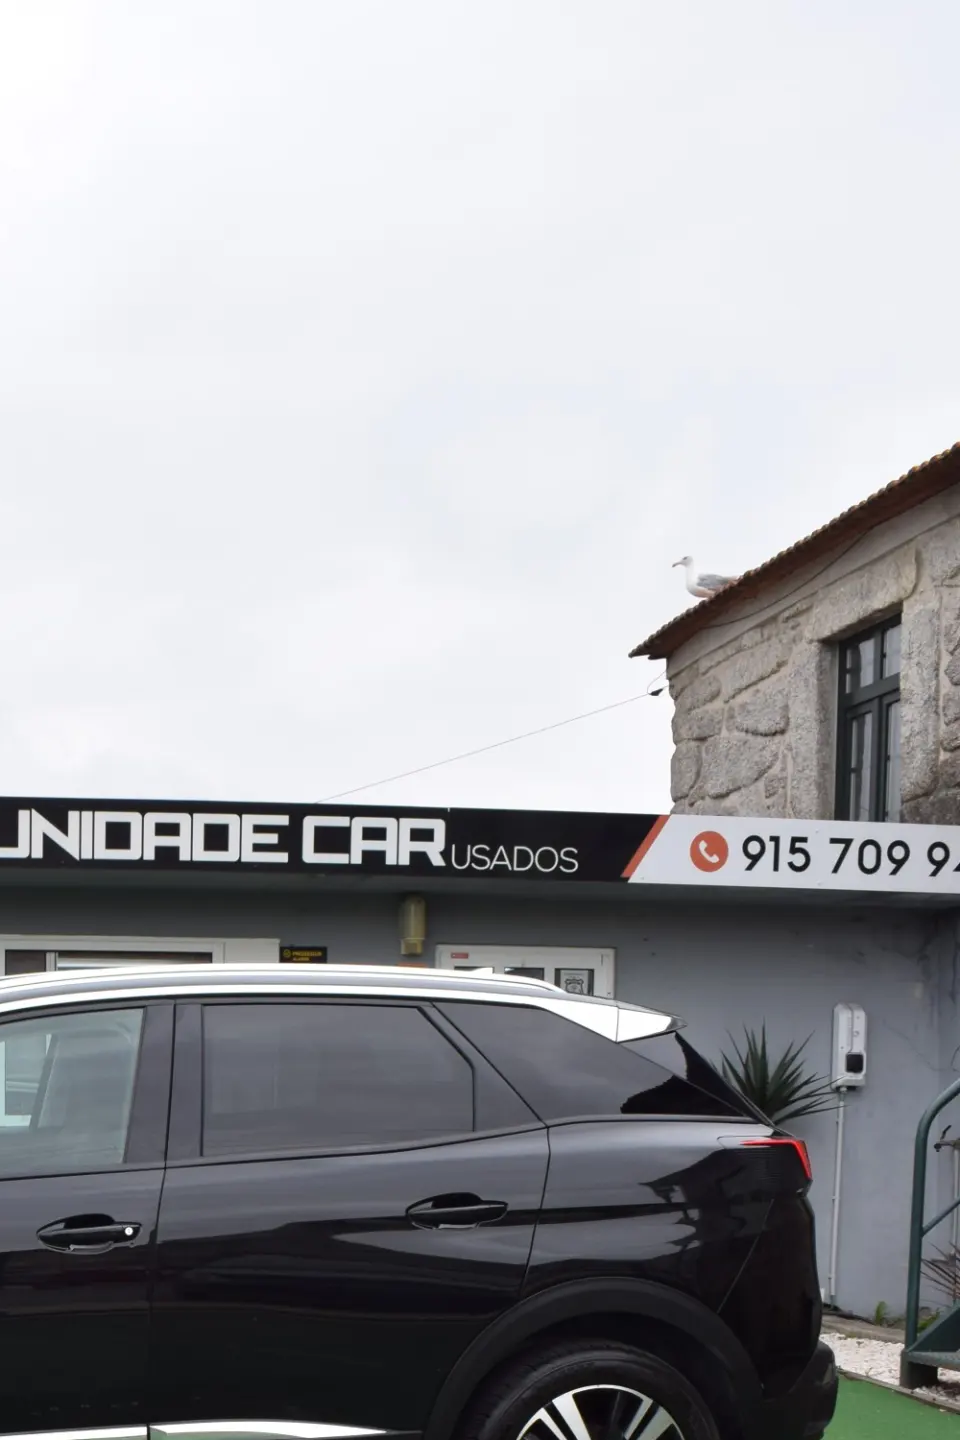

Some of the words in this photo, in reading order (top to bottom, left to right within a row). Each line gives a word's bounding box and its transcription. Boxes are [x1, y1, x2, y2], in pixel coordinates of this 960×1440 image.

[301, 815, 446, 867] CAR
[451, 844, 579, 873] USADOS
[742, 834, 811, 873] 915
[829, 837, 911, 876] 709
[926, 841, 960, 877] 9
